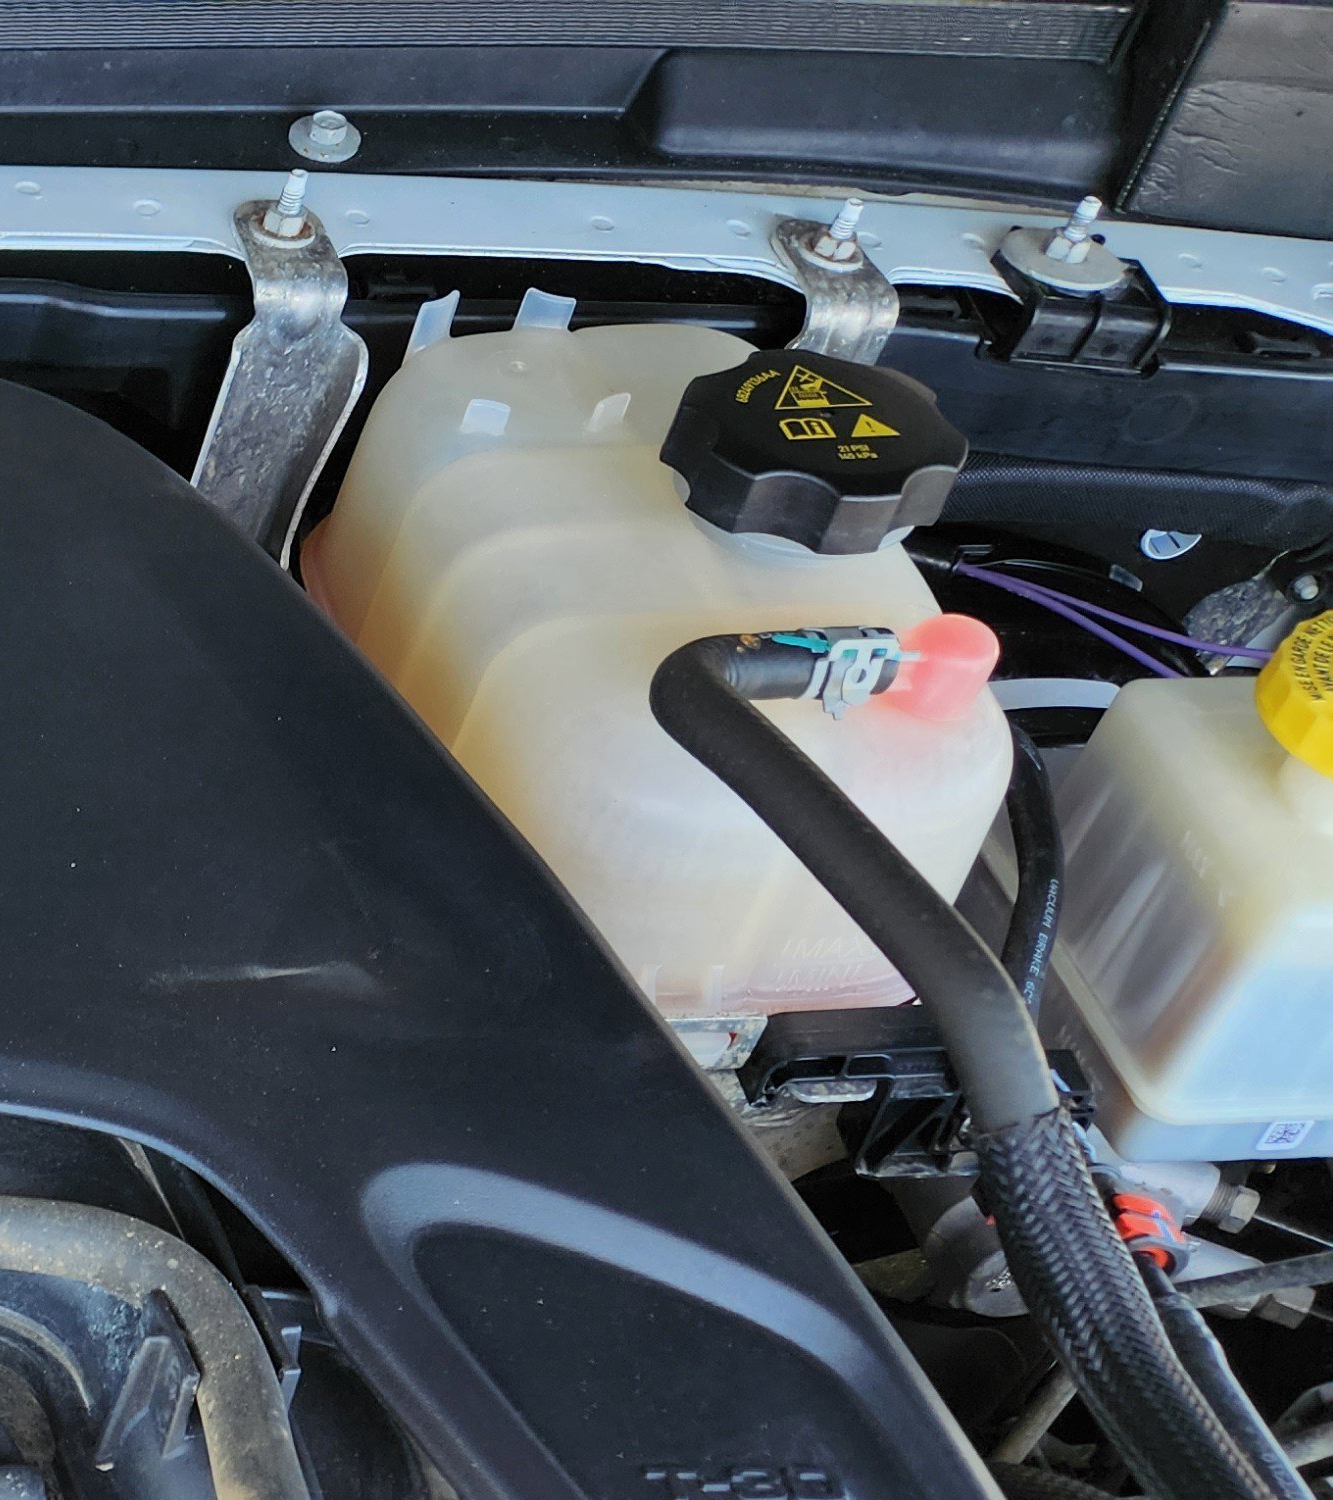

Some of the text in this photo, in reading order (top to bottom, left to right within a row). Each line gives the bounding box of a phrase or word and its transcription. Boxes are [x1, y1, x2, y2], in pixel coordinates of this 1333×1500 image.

[850, 444, 871, 452] PSI
[1043, 878, 1059, 929] VACUUM
[1029, 932, 1048, 976] BRAKE
